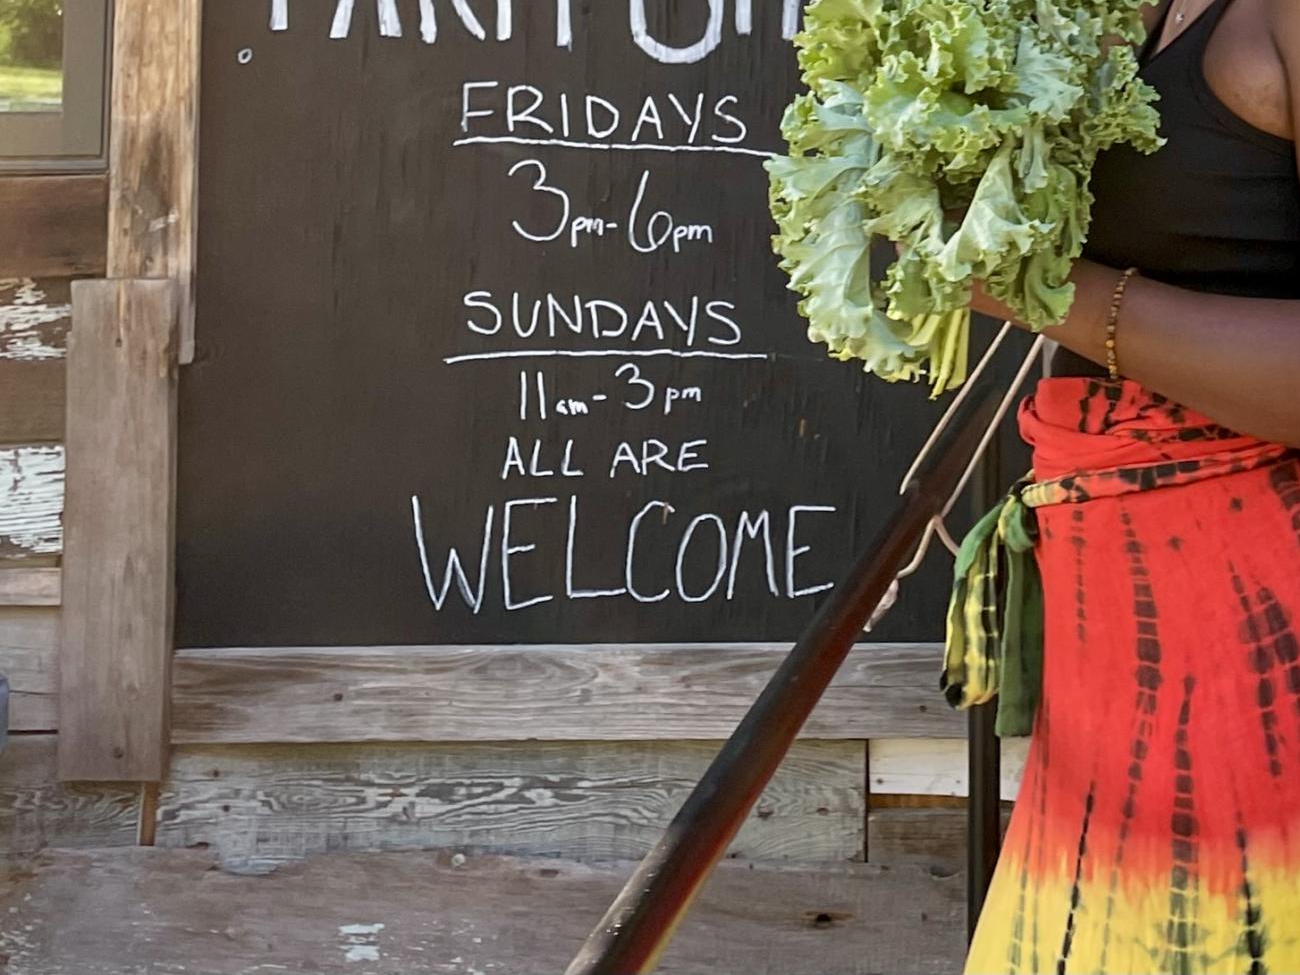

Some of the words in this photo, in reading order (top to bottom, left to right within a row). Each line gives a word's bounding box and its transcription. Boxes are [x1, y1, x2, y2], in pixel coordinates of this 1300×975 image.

[461, 82, 747, 143] FRIDAYS
[463, 290, 743, 346] SUNDAYS
[501, 436, 584, 480] ALL
[609, 438, 709, 478] ARE
[411, 495, 836, 614] WELCOME
